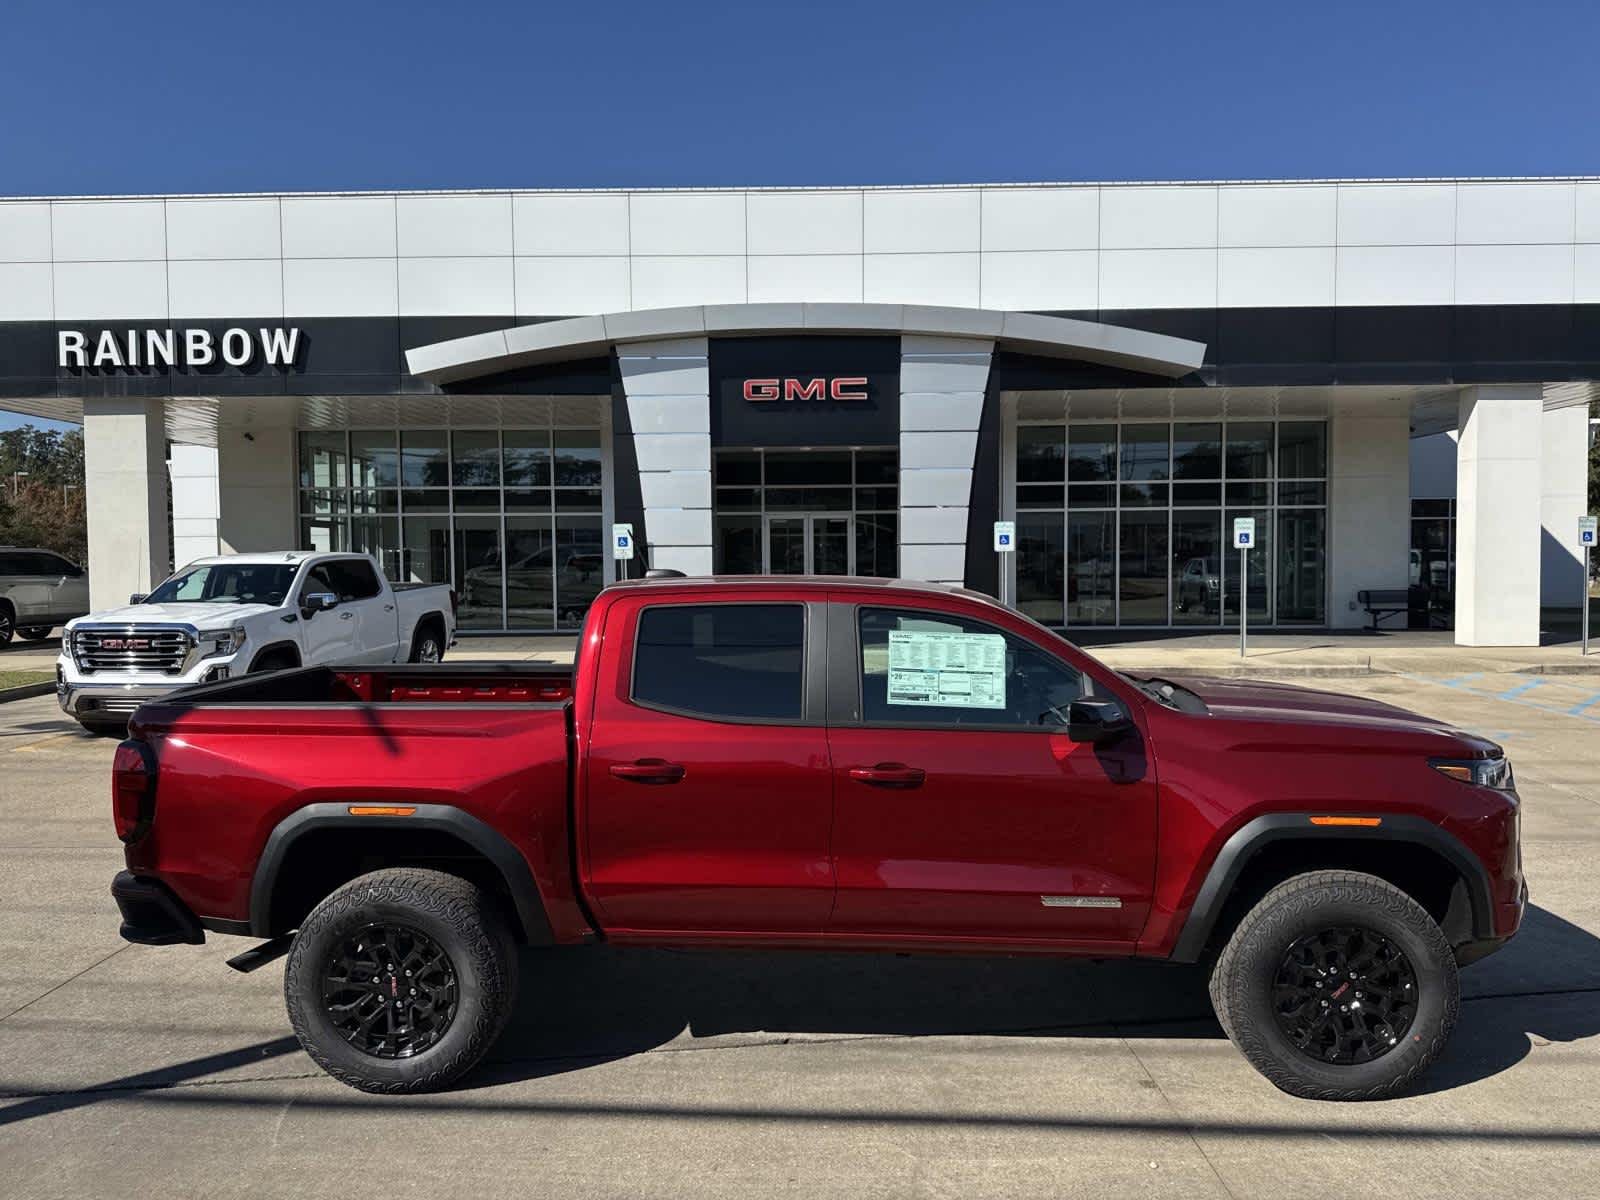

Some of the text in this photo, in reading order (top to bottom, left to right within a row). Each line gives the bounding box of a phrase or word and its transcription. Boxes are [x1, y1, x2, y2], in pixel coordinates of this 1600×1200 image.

[58, 328, 299, 367] RAINBOW
[743, 377, 868, 401] GMC
[101, 639, 149, 649] GMC
